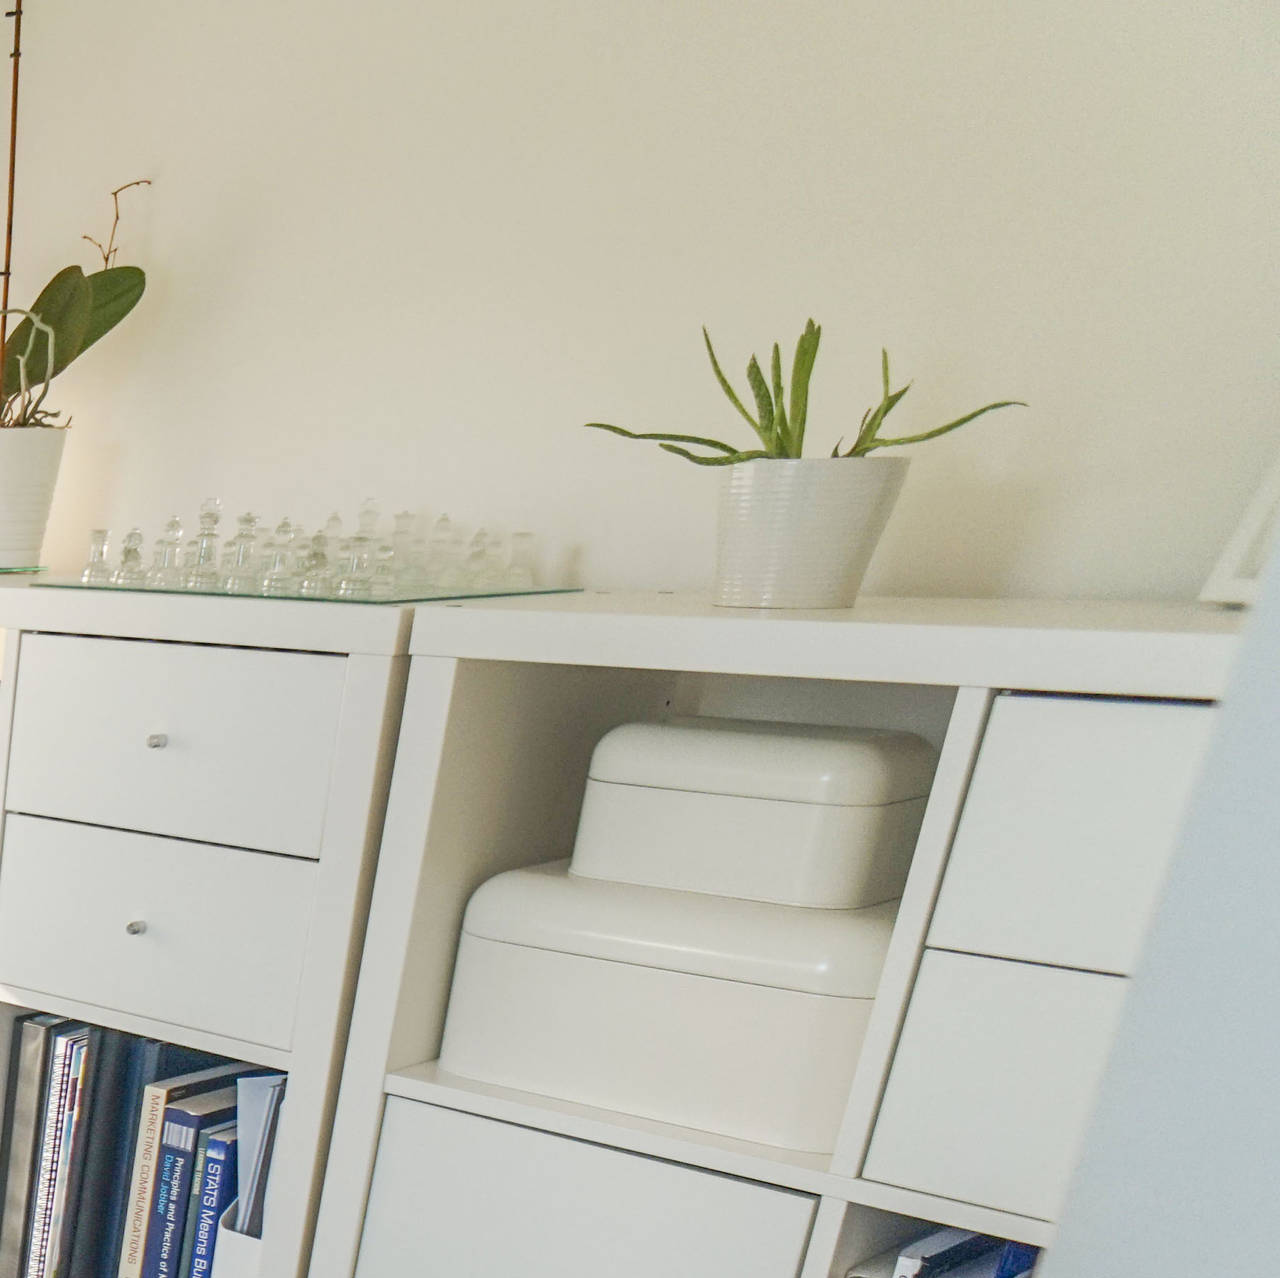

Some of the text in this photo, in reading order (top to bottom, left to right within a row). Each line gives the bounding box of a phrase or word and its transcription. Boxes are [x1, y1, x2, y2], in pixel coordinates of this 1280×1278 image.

[127, 1094, 160, 1263] MARKETING COMMUNICATIONS
[157, 1154, 173, 1214] David Jobber
[169, 1157, 184, 1200] Principles
[203, 1163, 220, 1205] STATS
[166, 1203, 175, 1220] and
[196, 1209, 214, 1254] Means
[160, 1222, 174, 1258] Practice
[159, 1261, 167, 1271] of
